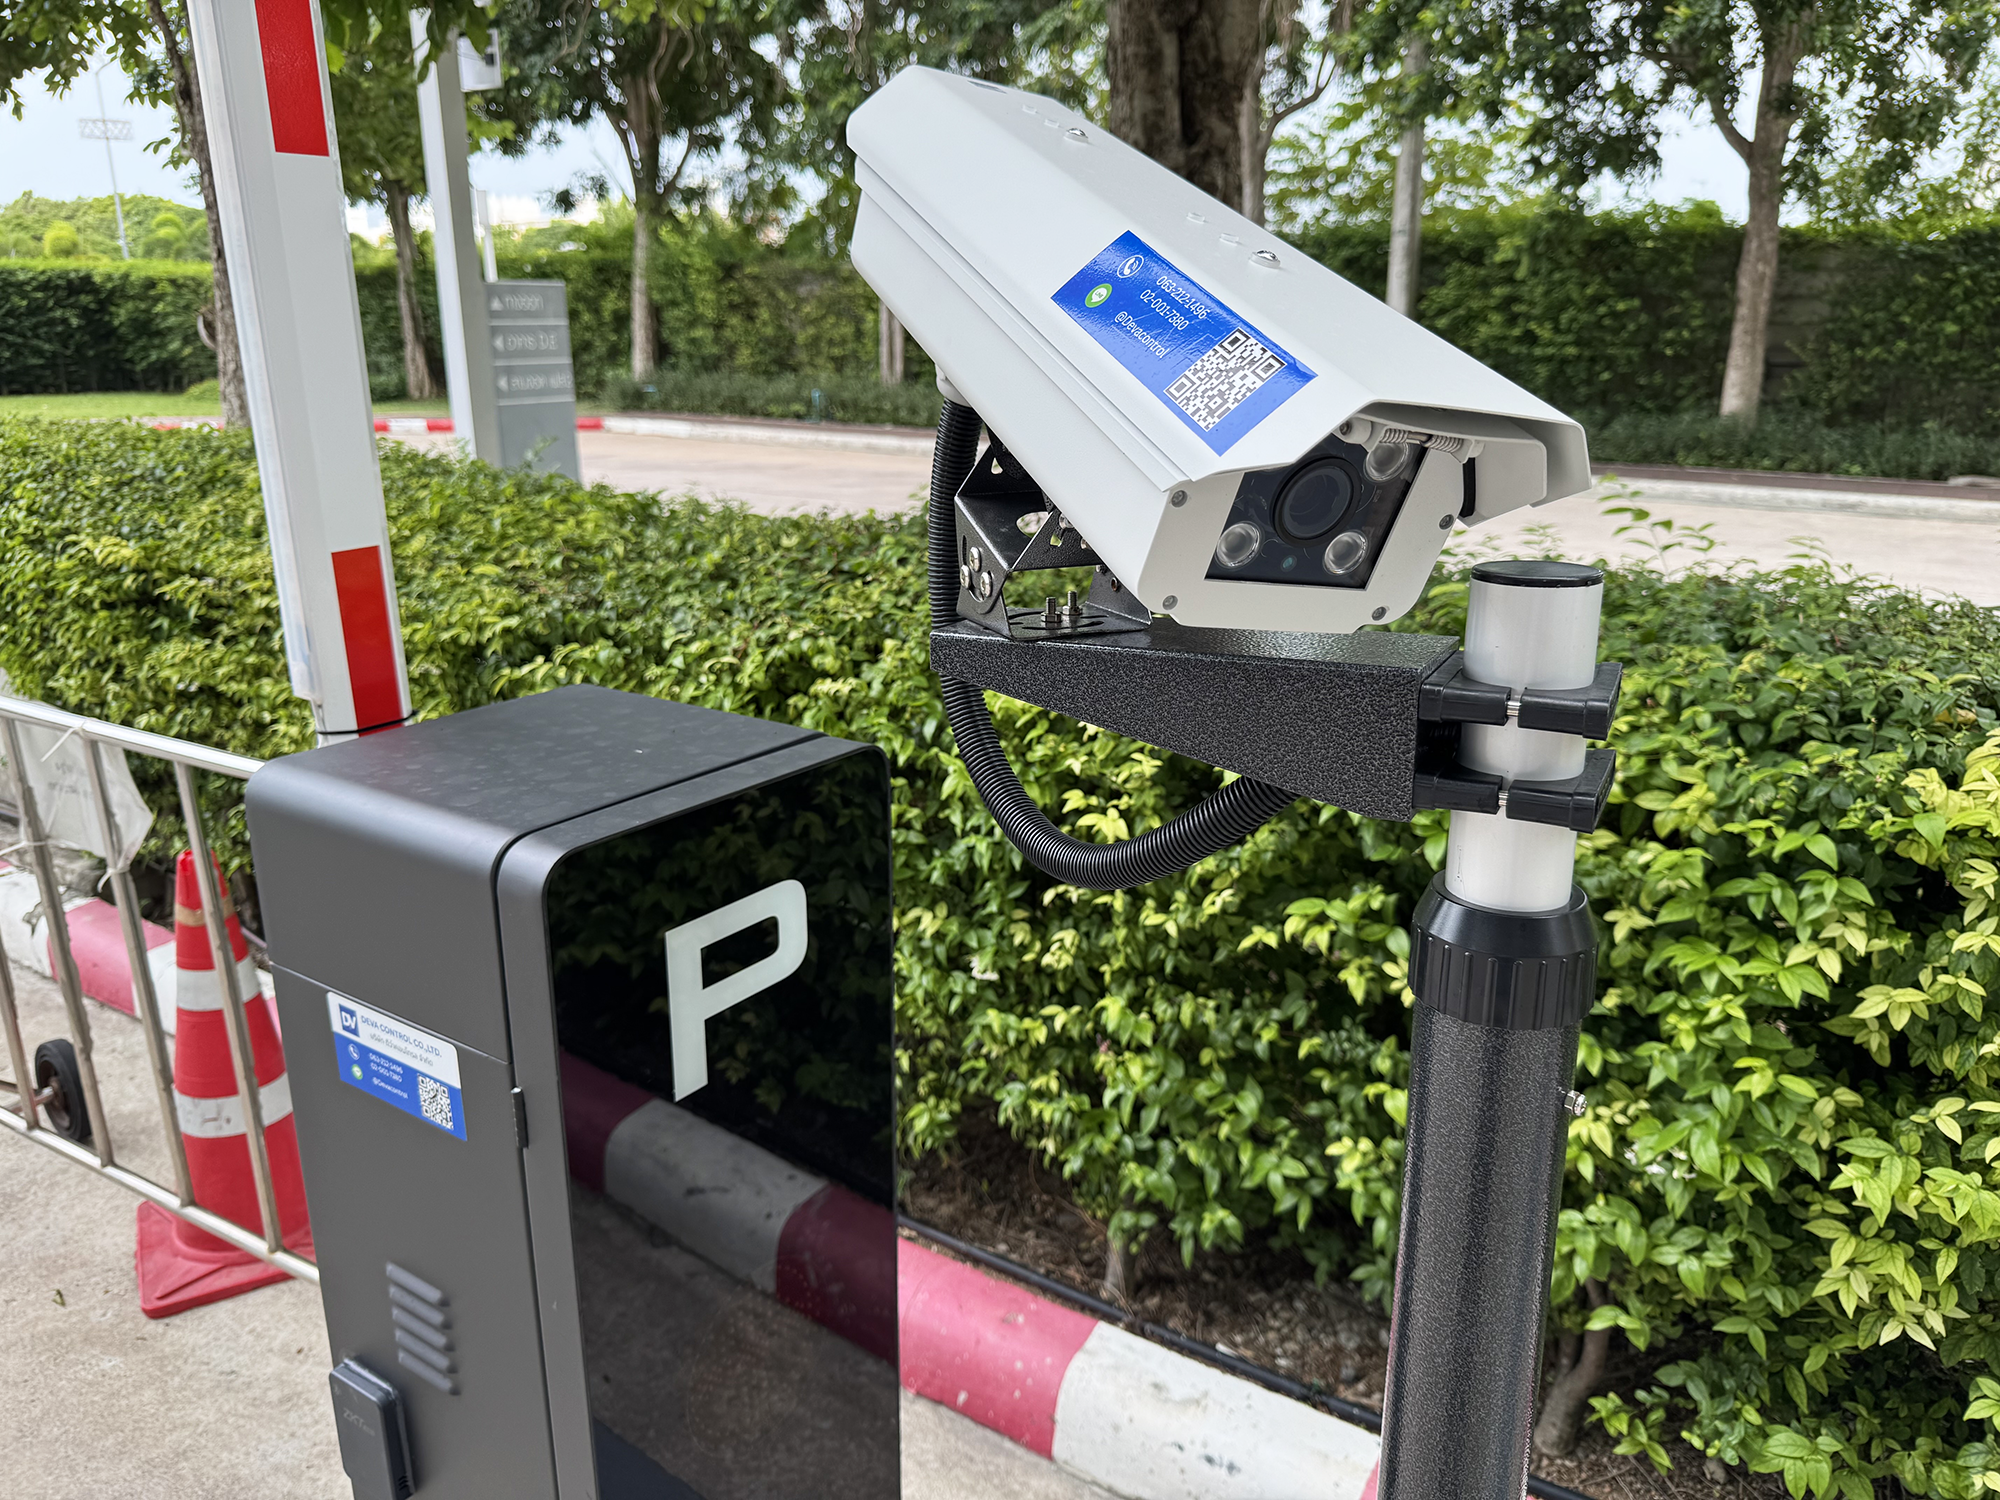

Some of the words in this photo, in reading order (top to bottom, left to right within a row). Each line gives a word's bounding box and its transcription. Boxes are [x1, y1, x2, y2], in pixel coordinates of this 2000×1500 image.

[1140, 289, 1189, 331] 02-001-7380
[1156, 275, 1210, 320] 063-212-1496
[1114, 311, 1170, 359] @Devacontrol
[665, 879, 808, 1102] P
[361, 1015, 379, 1030] DEVA
[380, 1024, 413, 1045] CONTROL
